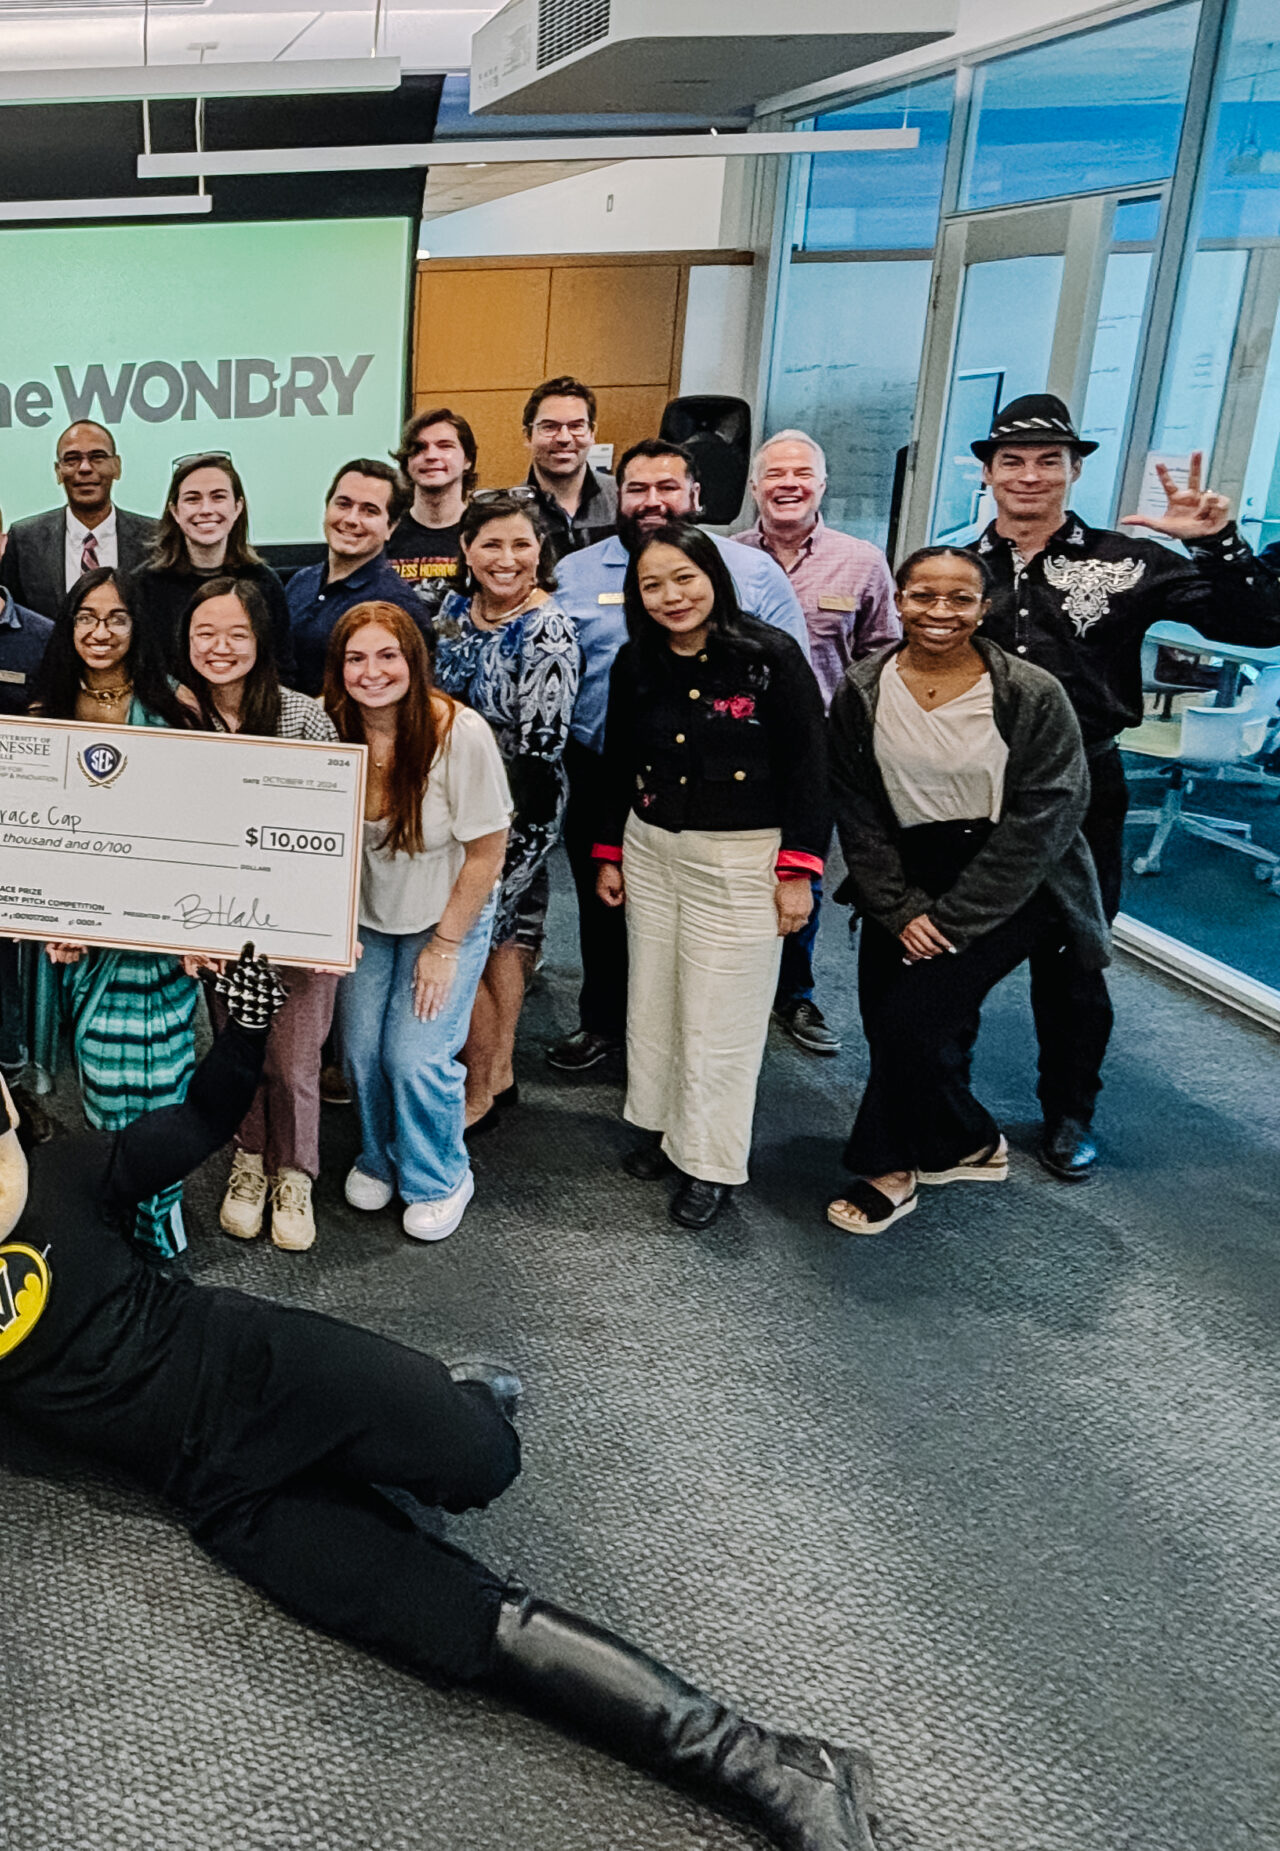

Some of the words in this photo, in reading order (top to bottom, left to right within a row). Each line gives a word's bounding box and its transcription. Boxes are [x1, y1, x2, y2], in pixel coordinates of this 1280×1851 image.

[90, 749, 114, 773] SEC
[327, 758, 351, 767] 2024
[47, 806, 82, 834] Cap
[3, 832, 63, 848] thousand
[64, 838, 91, 851] and
[92, 841, 132, 854] 0/100
[245, 826, 259, 847] $
[270, 832, 337, 852] 10,000
[18, 887, 42, 896] PRIZE
[21, 896, 46, 905] PITCH
[47, 900, 105, 911] COMPETITION
